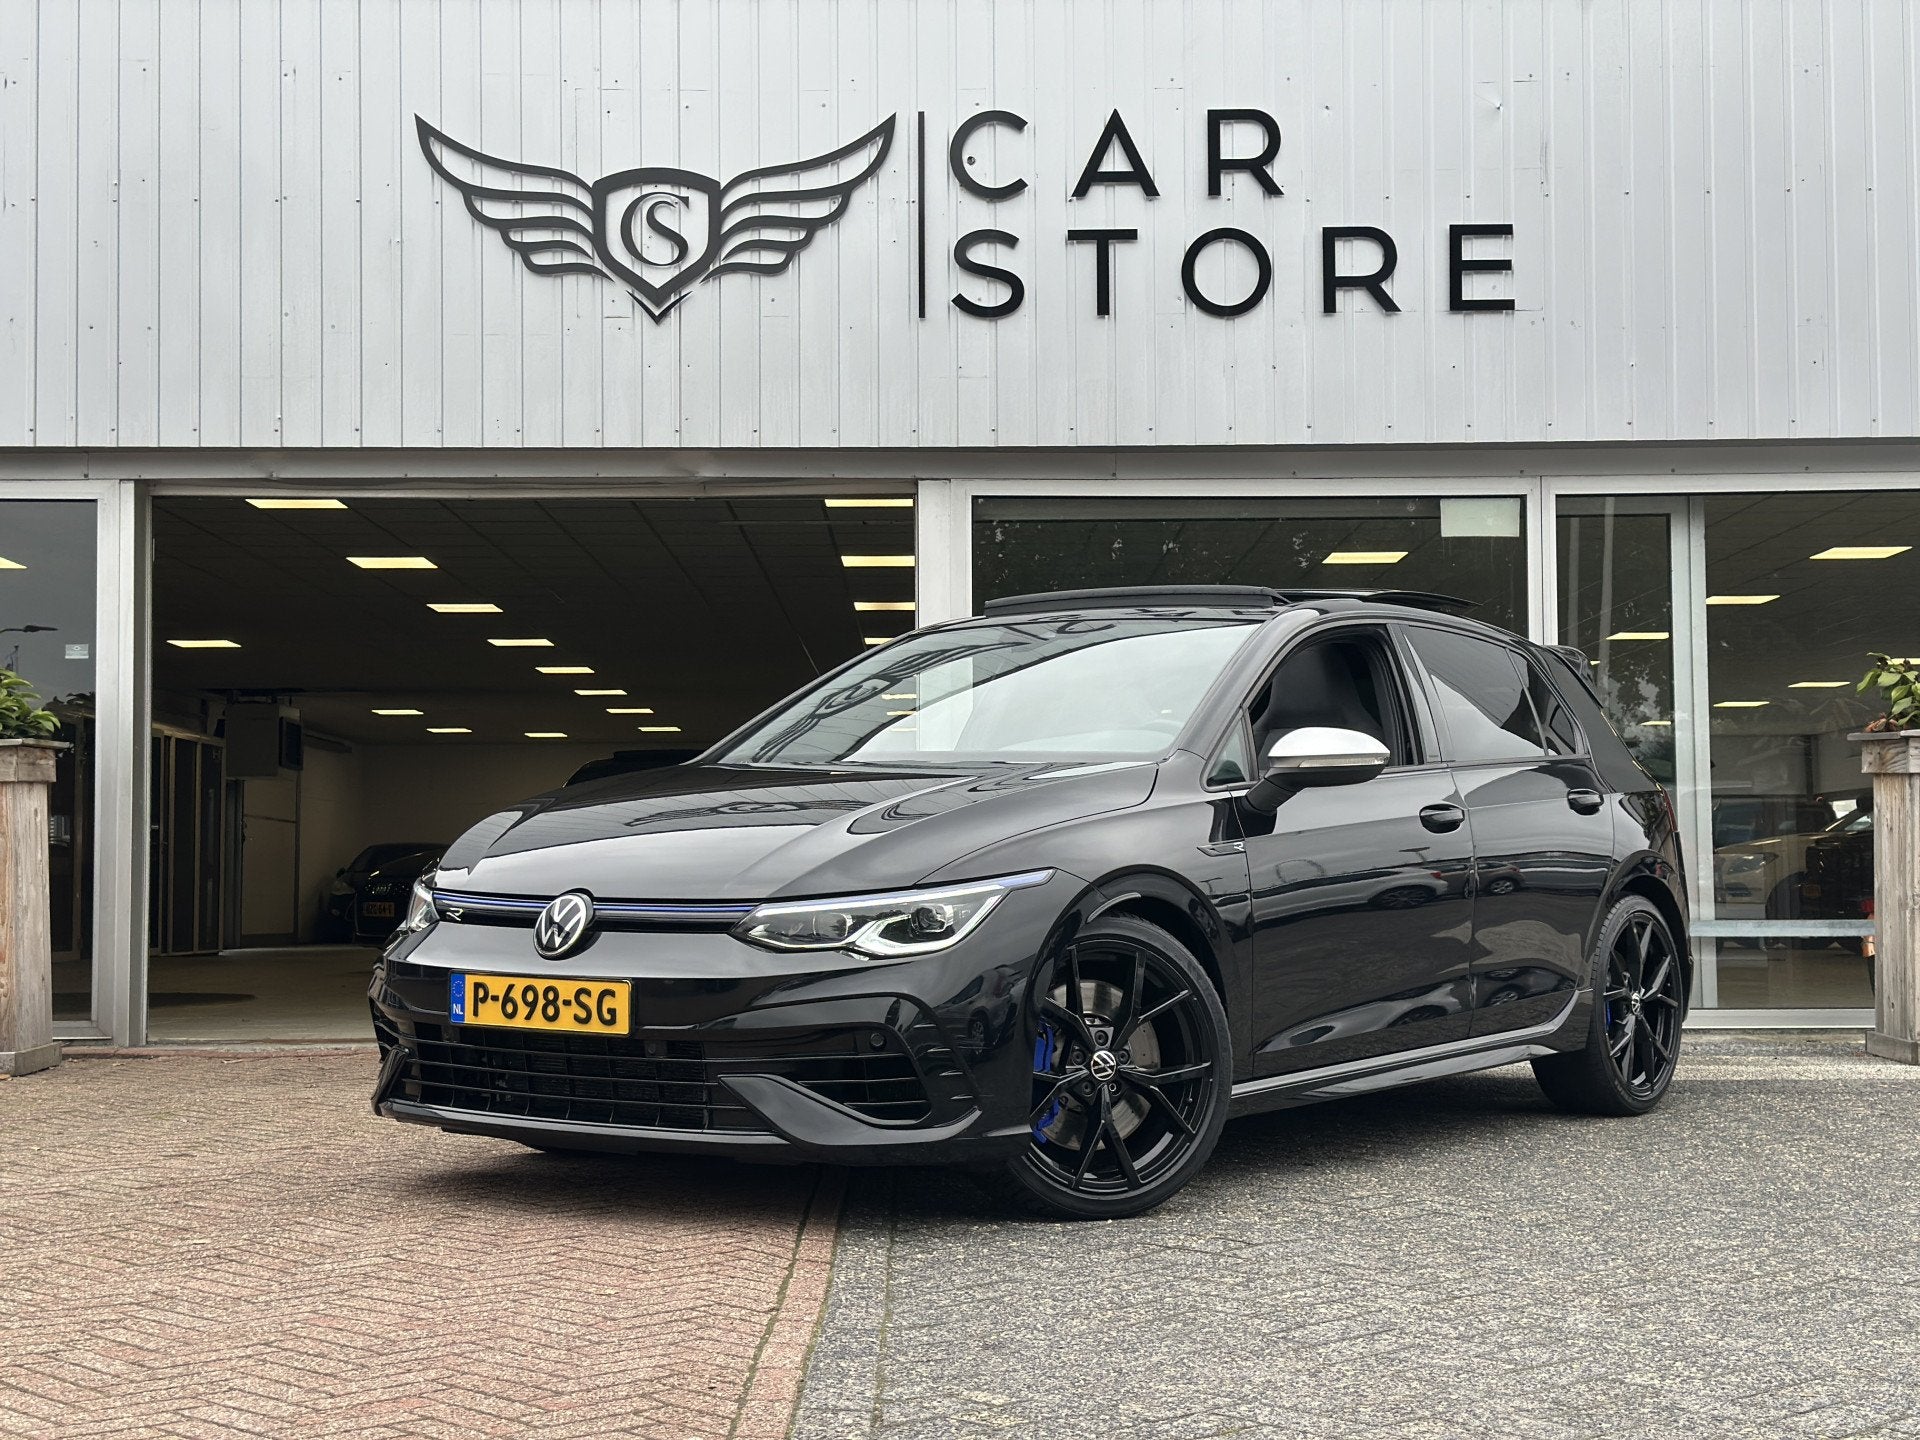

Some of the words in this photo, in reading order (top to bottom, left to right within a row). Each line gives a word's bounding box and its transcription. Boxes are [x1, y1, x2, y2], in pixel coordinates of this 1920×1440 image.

[949, 108, 1284, 199] CAR
[951, 224, 1516, 318] STORE
[452, 1003, 464, 1015] NL
[472, 981, 617, 1027] P-698-SG
